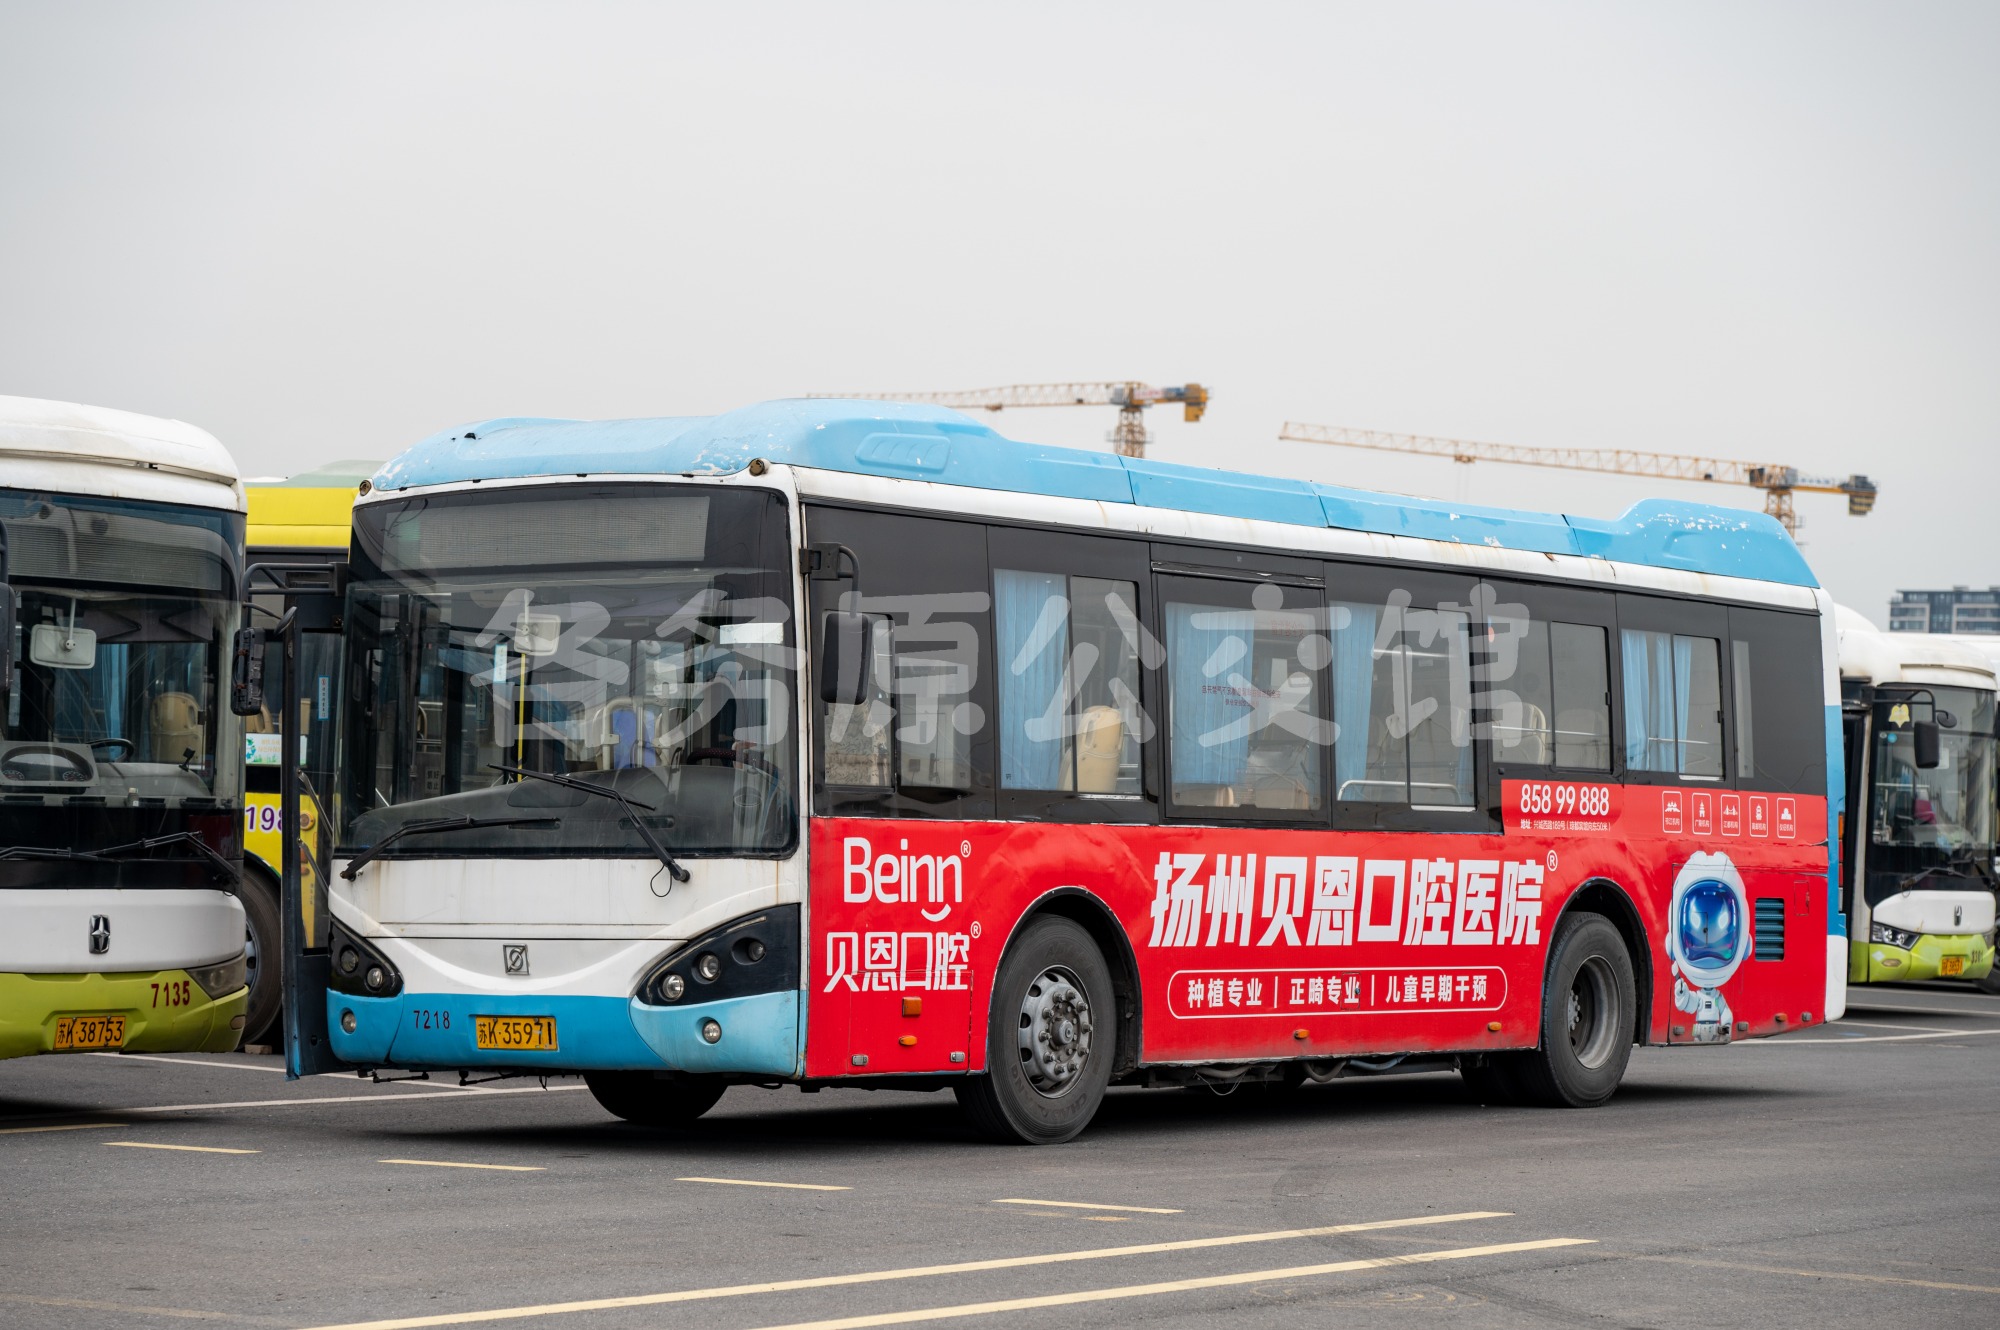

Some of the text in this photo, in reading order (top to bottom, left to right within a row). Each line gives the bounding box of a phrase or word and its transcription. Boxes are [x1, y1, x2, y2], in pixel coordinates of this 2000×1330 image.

[1520, 783, 1610, 816] 858 99 888
[151, 980, 191, 1008] 7135
[1187, 974, 1488, 1009] 种植专业 正畸专业 儿童早期干预
[413, 1010, 451, 1030] 7218
